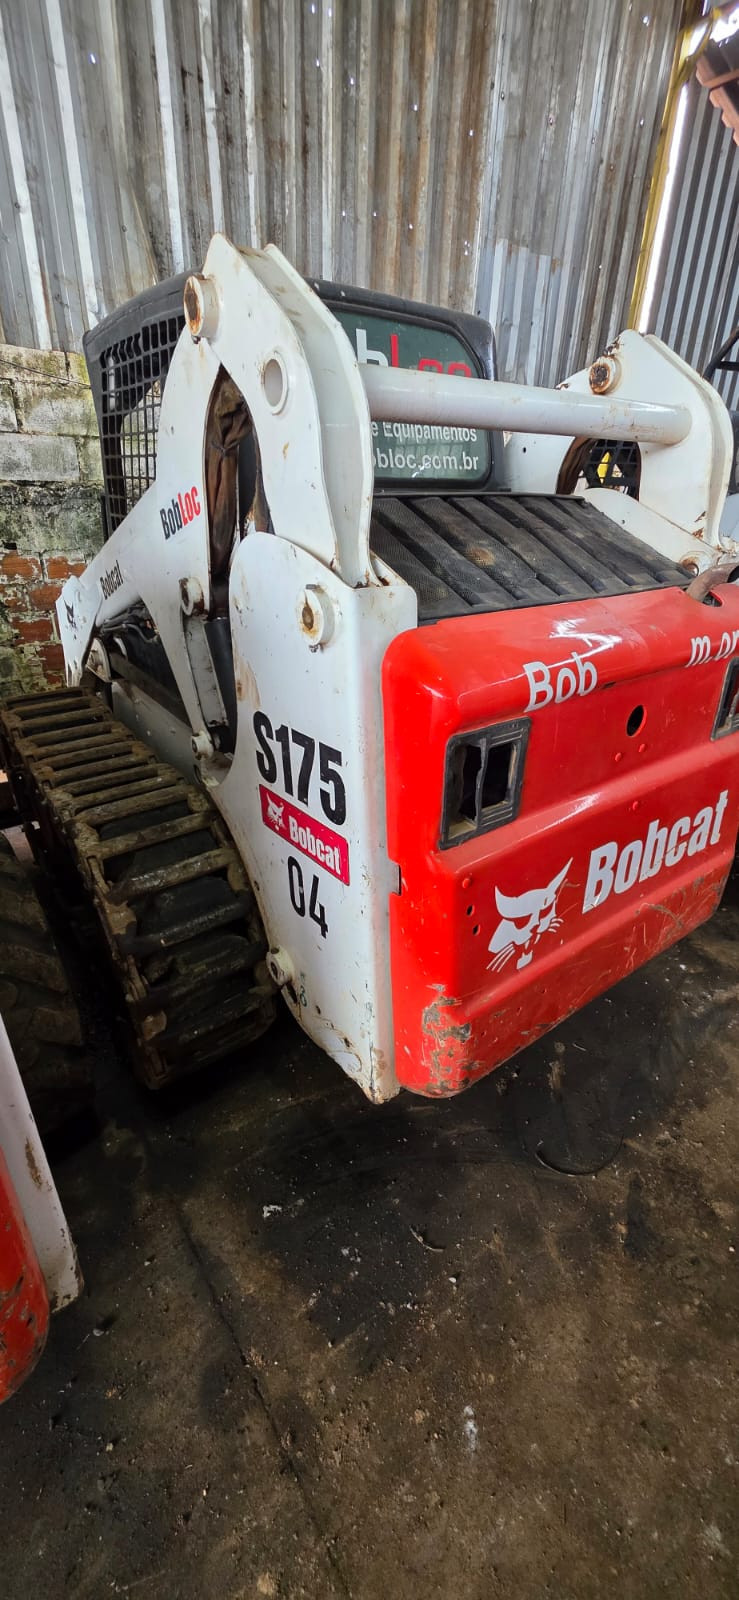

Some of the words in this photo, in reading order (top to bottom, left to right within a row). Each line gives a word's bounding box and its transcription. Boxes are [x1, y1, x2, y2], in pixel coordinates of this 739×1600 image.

[383, 421, 477, 443] Equipamentos
[100, 560, 124, 600] Bobcat
[523, 651, 598, 712] Bob
[253, 711, 347, 825] S175
[288, 815, 342, 875] Bobcat
[582, 790, 729, 914] Bobcat
[288, 856, 329, 939] 04
